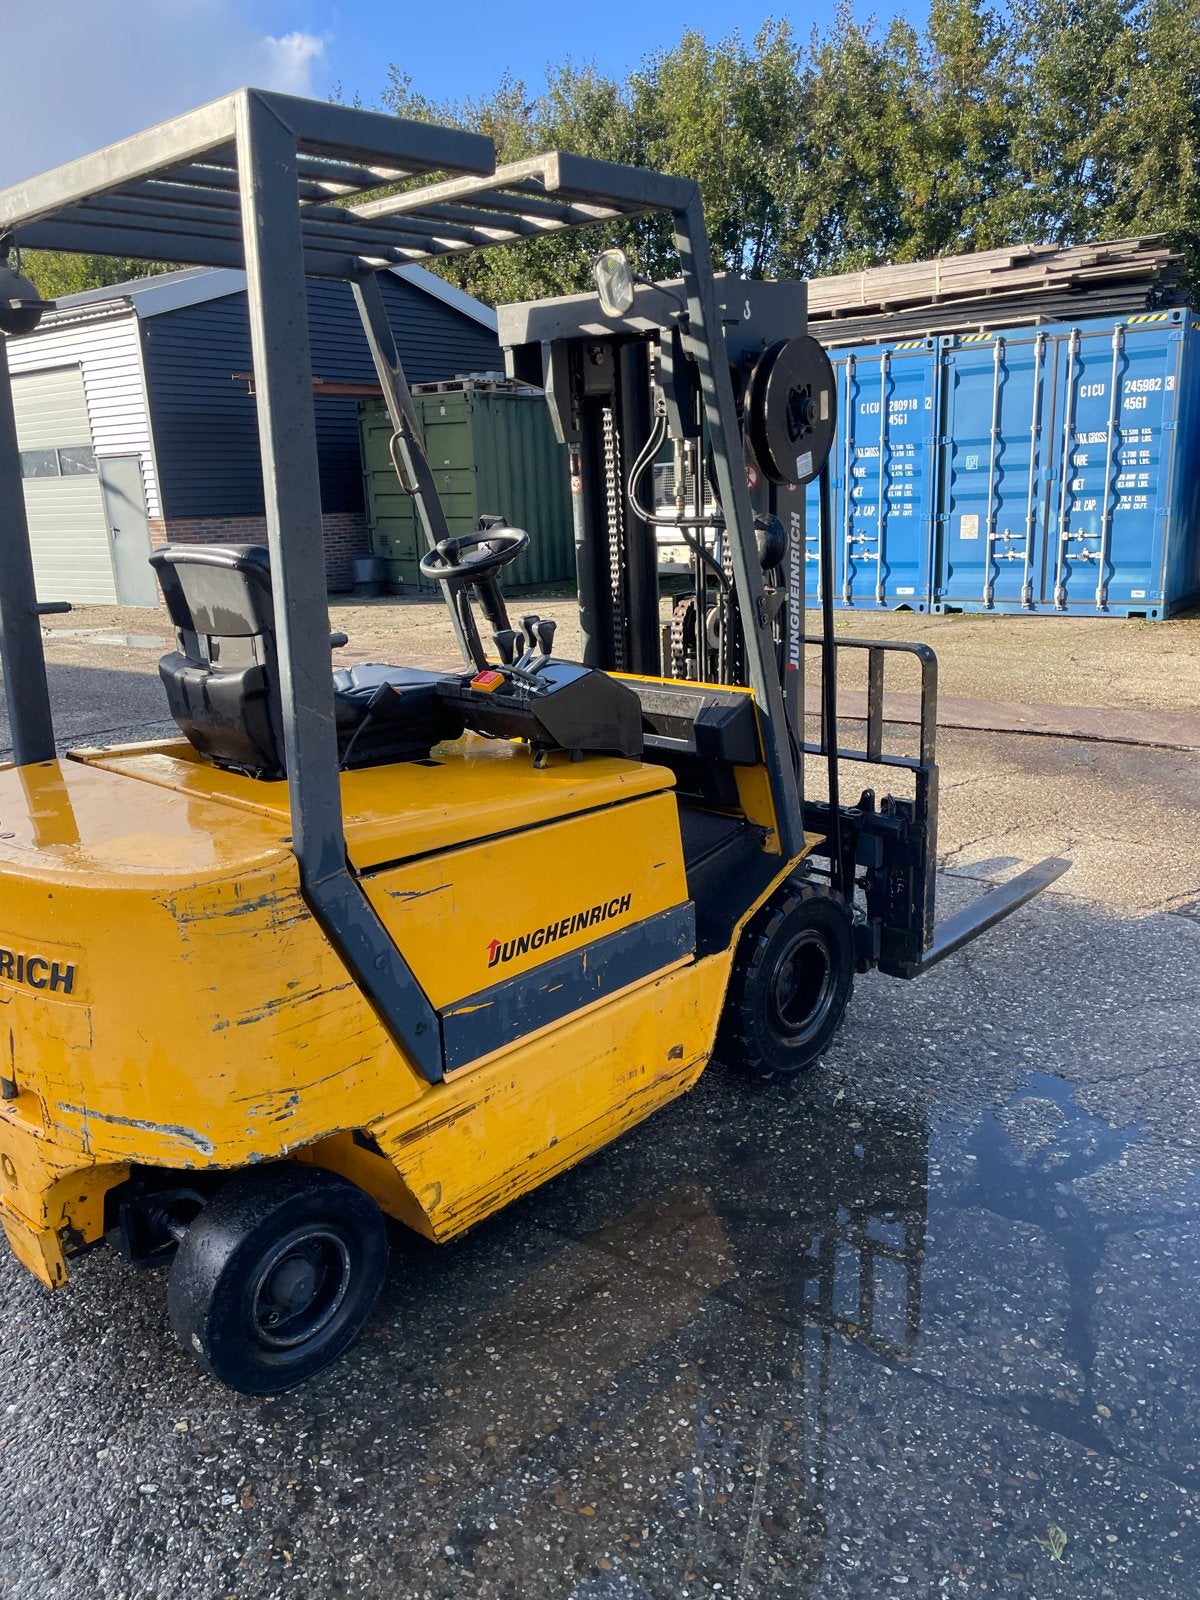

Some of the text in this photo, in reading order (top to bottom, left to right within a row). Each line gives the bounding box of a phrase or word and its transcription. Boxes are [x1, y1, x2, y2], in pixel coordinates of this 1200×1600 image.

[1080, 376, 1175, 398] CICU 245982 3
[860, 402, 880, 415] CICU
[888, 399, 918, 412] 280918
[1123, 396, 1147, 410] 45G1
[888, 413, 908, 426] 45G1
[787, 511, 801, 671] JUNGHEINRICH
[487, 892, 632, 969] JUNGHEINRICH
[0, 948, 75, 995] RICH
